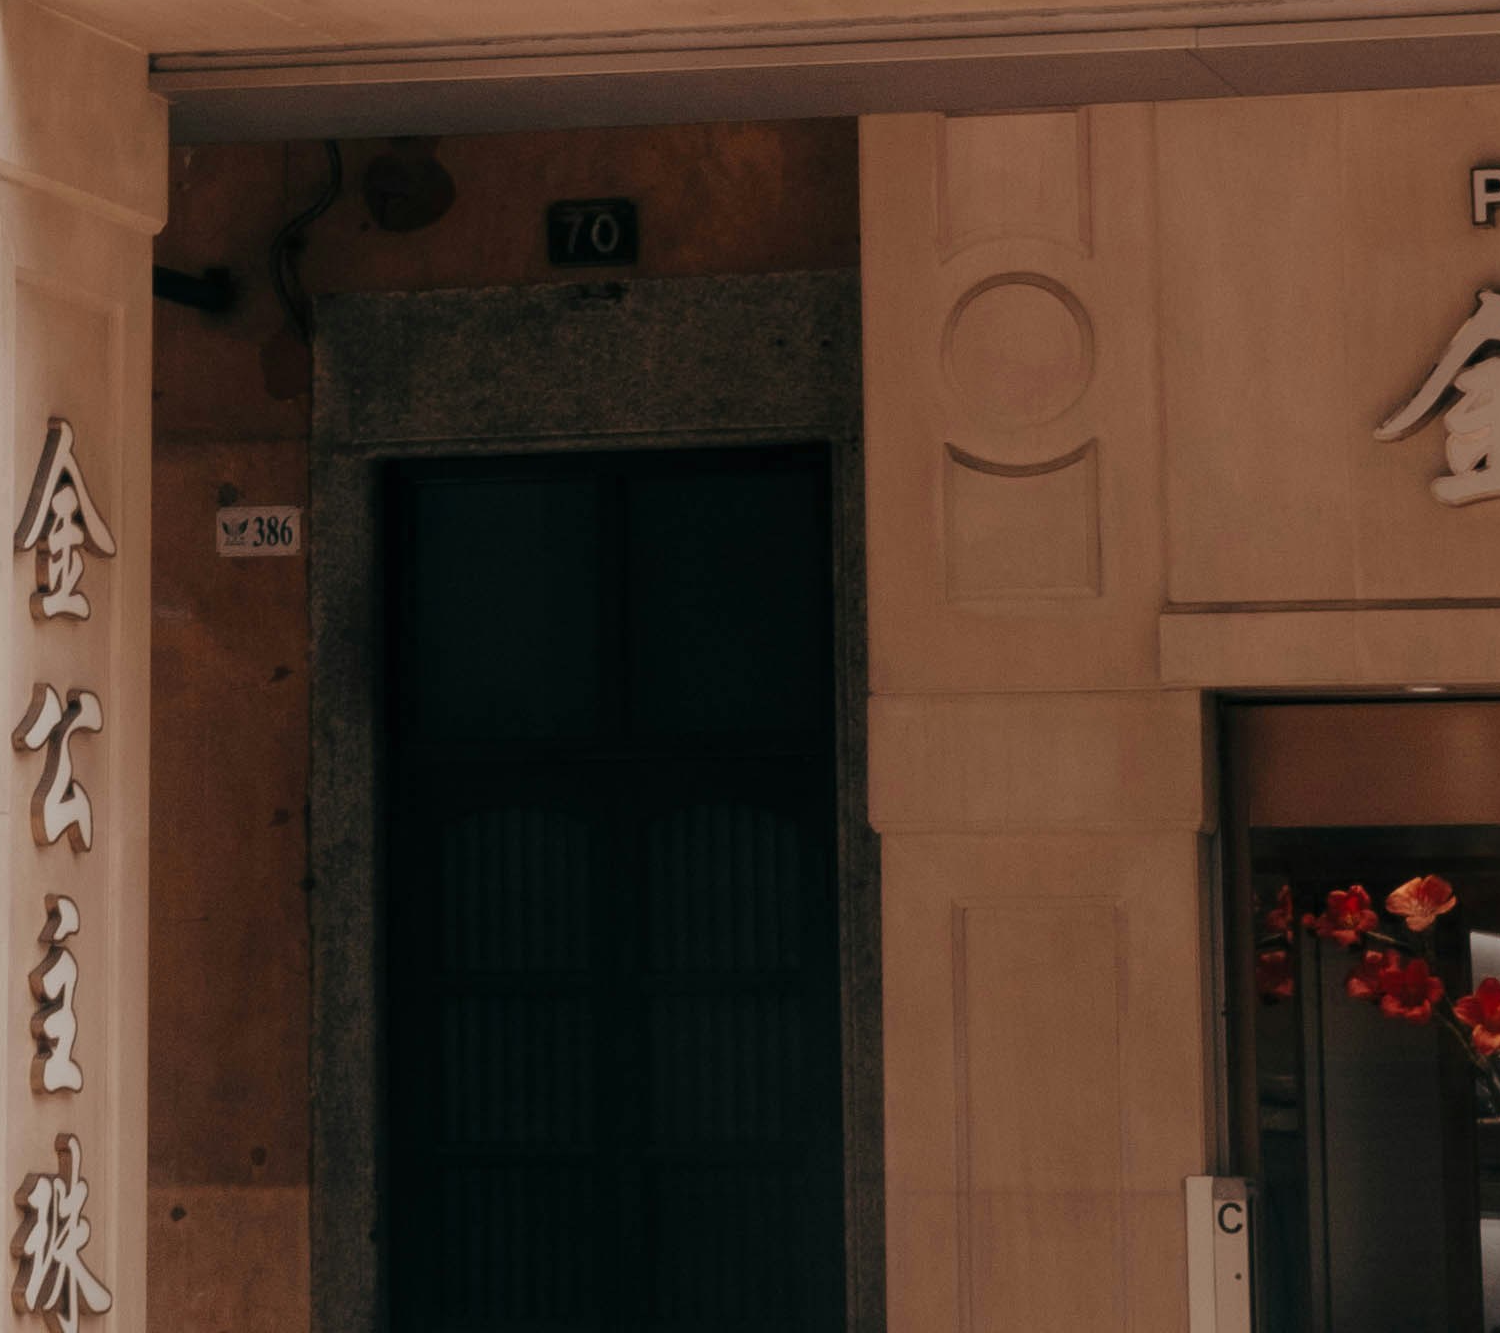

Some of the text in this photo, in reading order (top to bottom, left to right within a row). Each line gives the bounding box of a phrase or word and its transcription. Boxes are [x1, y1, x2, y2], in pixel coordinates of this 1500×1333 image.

[559, 212, 621, 254] 70
[252, 515, 294, 548] 386
[1217, 1201, 1244, 1235] C
